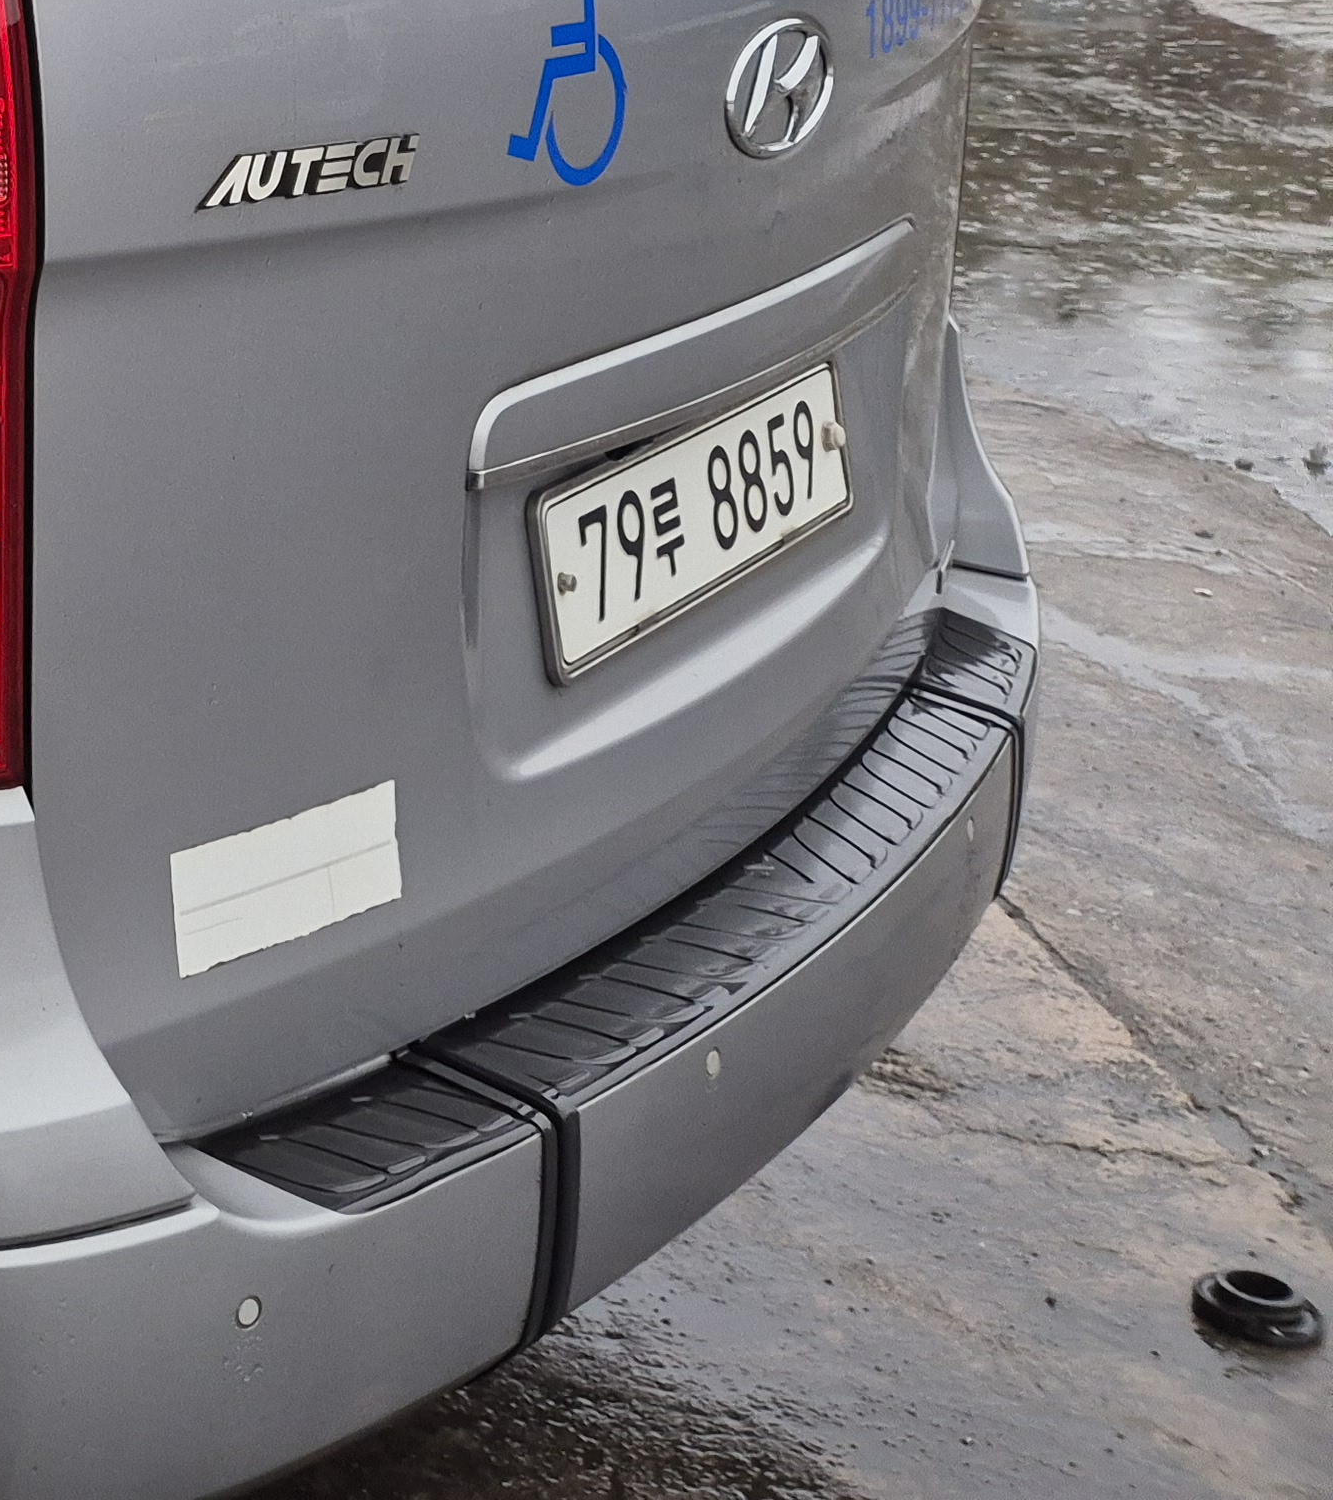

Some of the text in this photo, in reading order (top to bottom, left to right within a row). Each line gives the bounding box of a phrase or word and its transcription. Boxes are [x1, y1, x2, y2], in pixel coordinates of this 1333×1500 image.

[199, 134, 420, 208] AUTECH
[577, 400, 814, 622] 79루 8859
